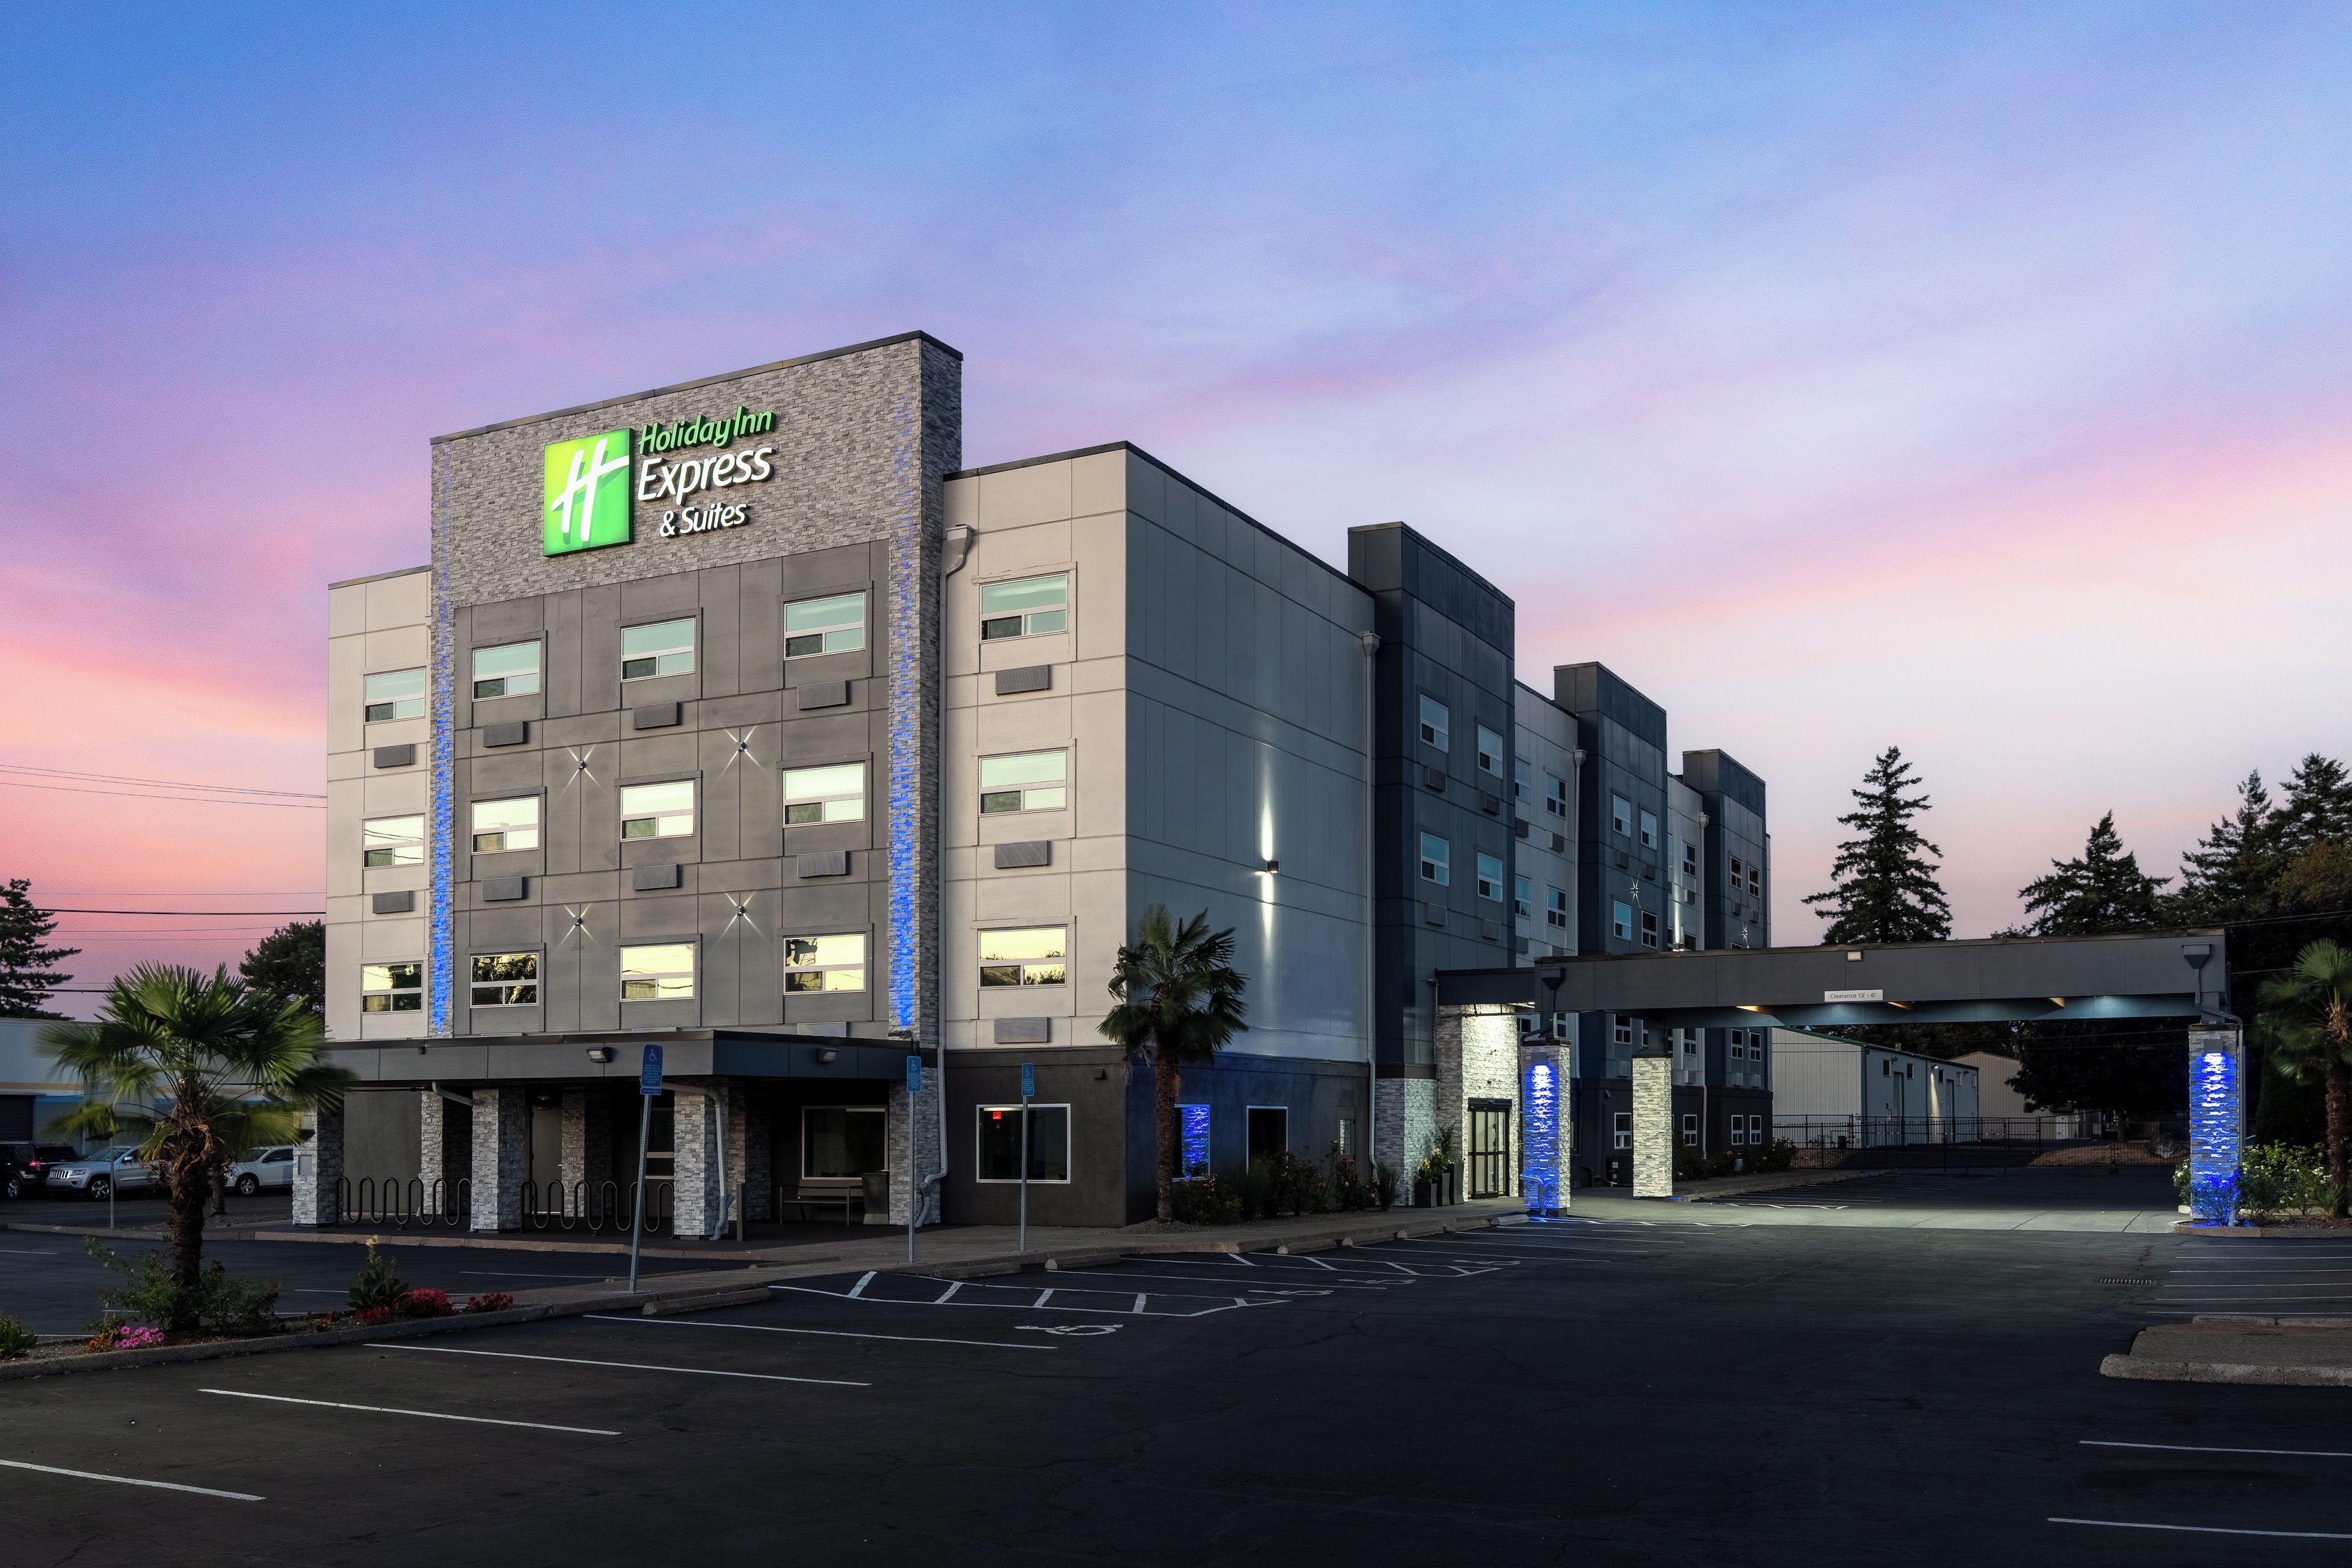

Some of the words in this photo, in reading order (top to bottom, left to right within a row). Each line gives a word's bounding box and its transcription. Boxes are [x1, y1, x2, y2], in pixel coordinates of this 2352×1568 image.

[638, 414, 732, 454] Holiday
[733, 405, 772, 437] Inn
[638, 447, 773, 505] Express
[659, 510, 676, 537] &
[679, 502, 747, 534] Suites
